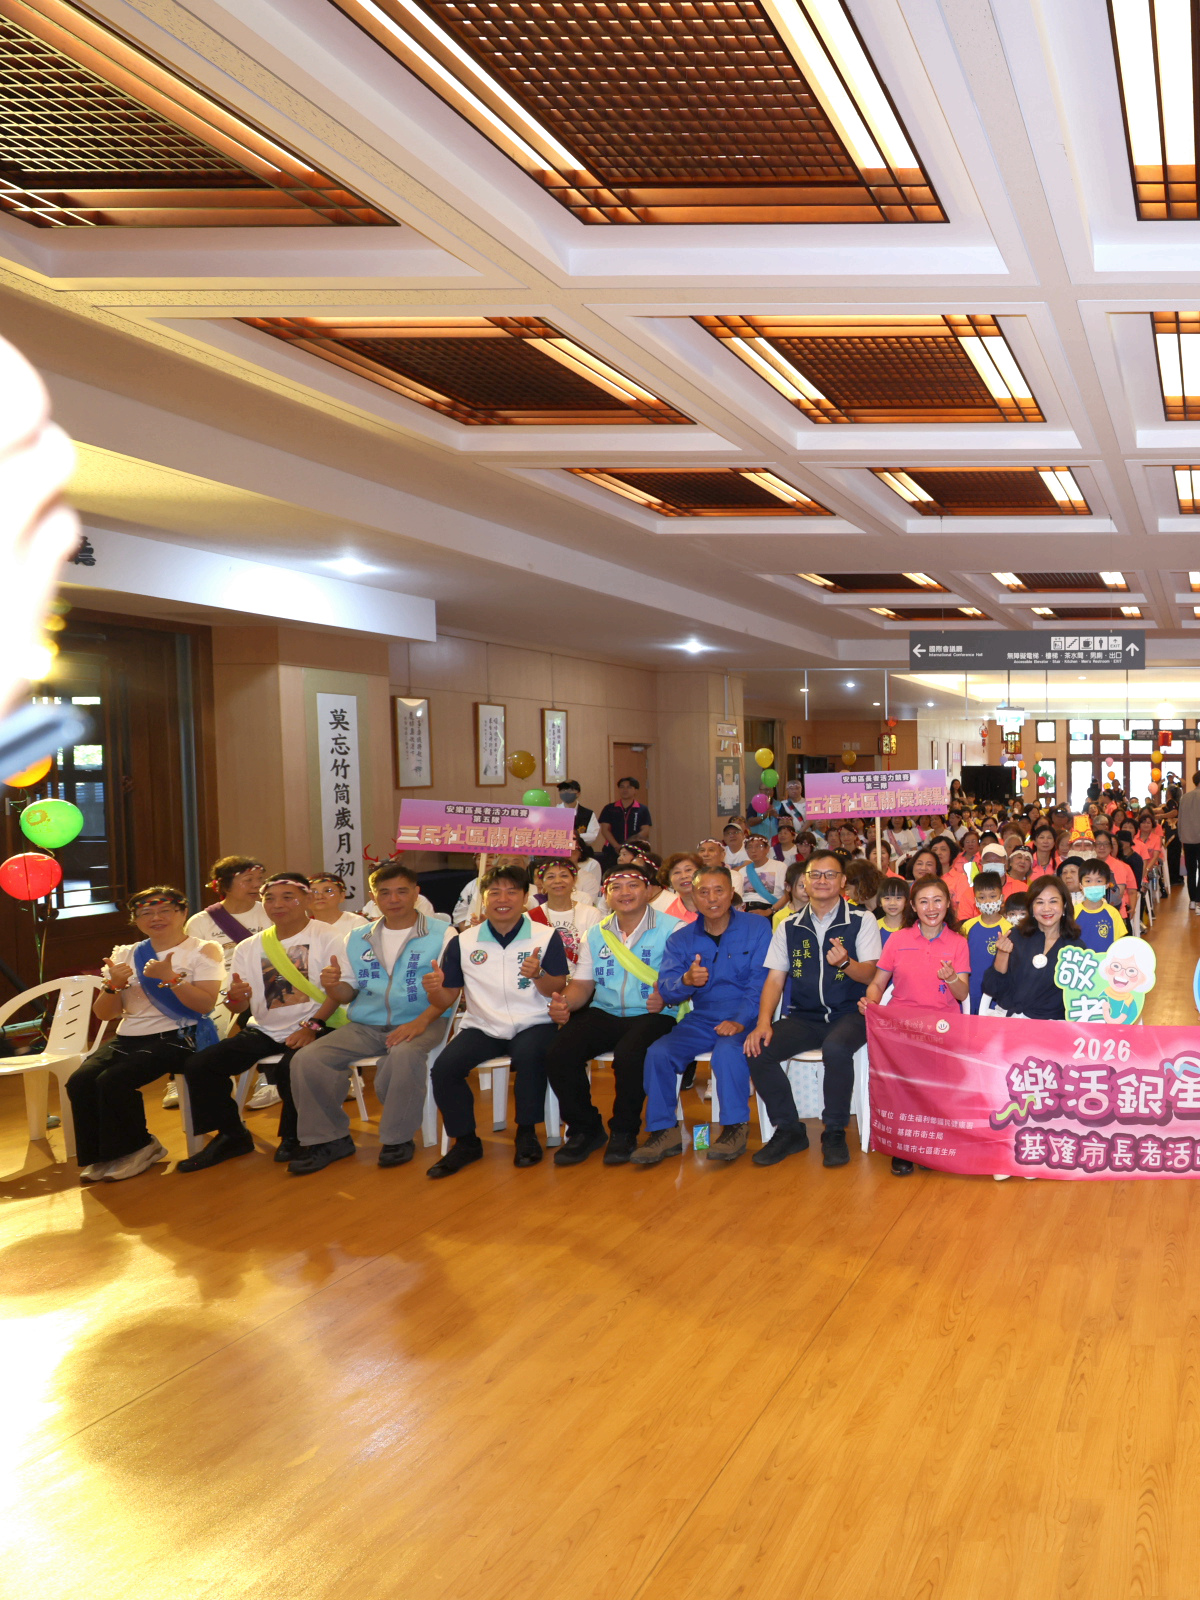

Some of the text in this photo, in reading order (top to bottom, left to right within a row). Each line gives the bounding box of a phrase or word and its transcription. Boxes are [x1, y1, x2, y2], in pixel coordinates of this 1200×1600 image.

[1006, 652, 1040, 660] 無障礙電梯
[1064, 652, 1084, 660] 茶水間
[1108, 651, 1122, 659] 出口
[805, 786, 951, 815] 五福社區關懷據點
[445, 804, 530, 818] 安樂區長者活力競賽
[472, 815, 502, 825] 第五隊
[397, 824, 577, 850] 三民社區關懷據點
[802, 939, 812, 959] 區長
[517, 951, 531, 990] 張豪
[1073, 1037, 1131, 1062] 2026
[897, 1127, 945, 1141] 基隆市衛生局
[896, 1141, 957, 1157] 基隆市七區衛生所
